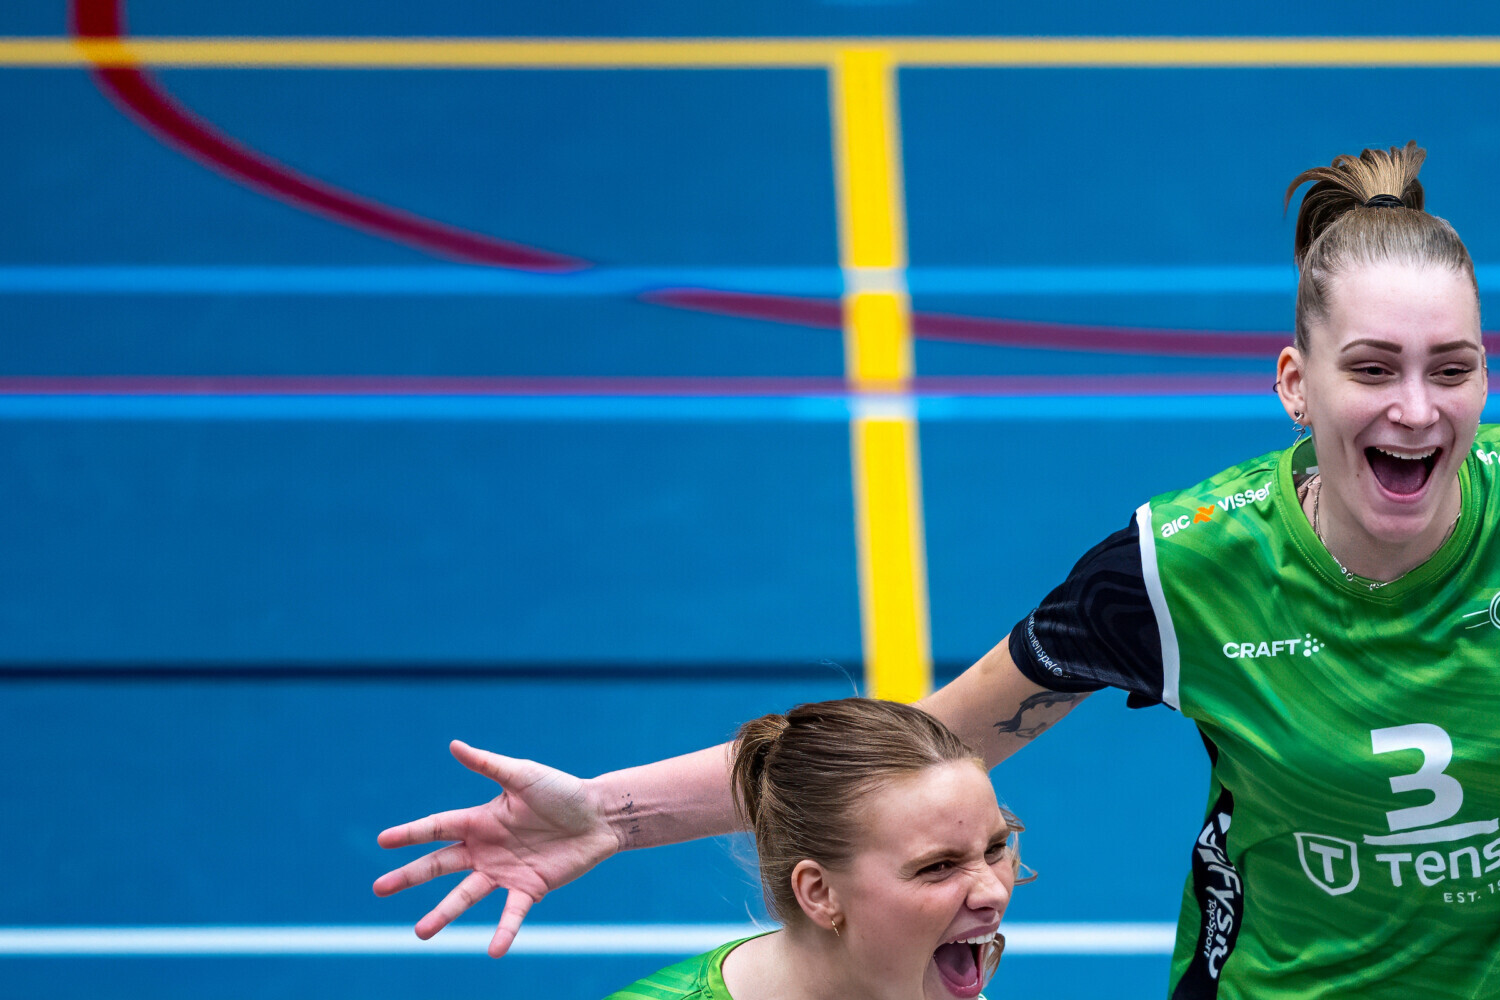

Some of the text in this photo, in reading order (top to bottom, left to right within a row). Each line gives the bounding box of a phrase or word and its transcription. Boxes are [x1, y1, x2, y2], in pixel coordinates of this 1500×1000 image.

[1217, 482, 1273, 512] visser
[1222, 638, 1302, 659] CRAFT
[1370, 722, 1464, 833] 3
[1443, 892, 1482, 904] EST.
